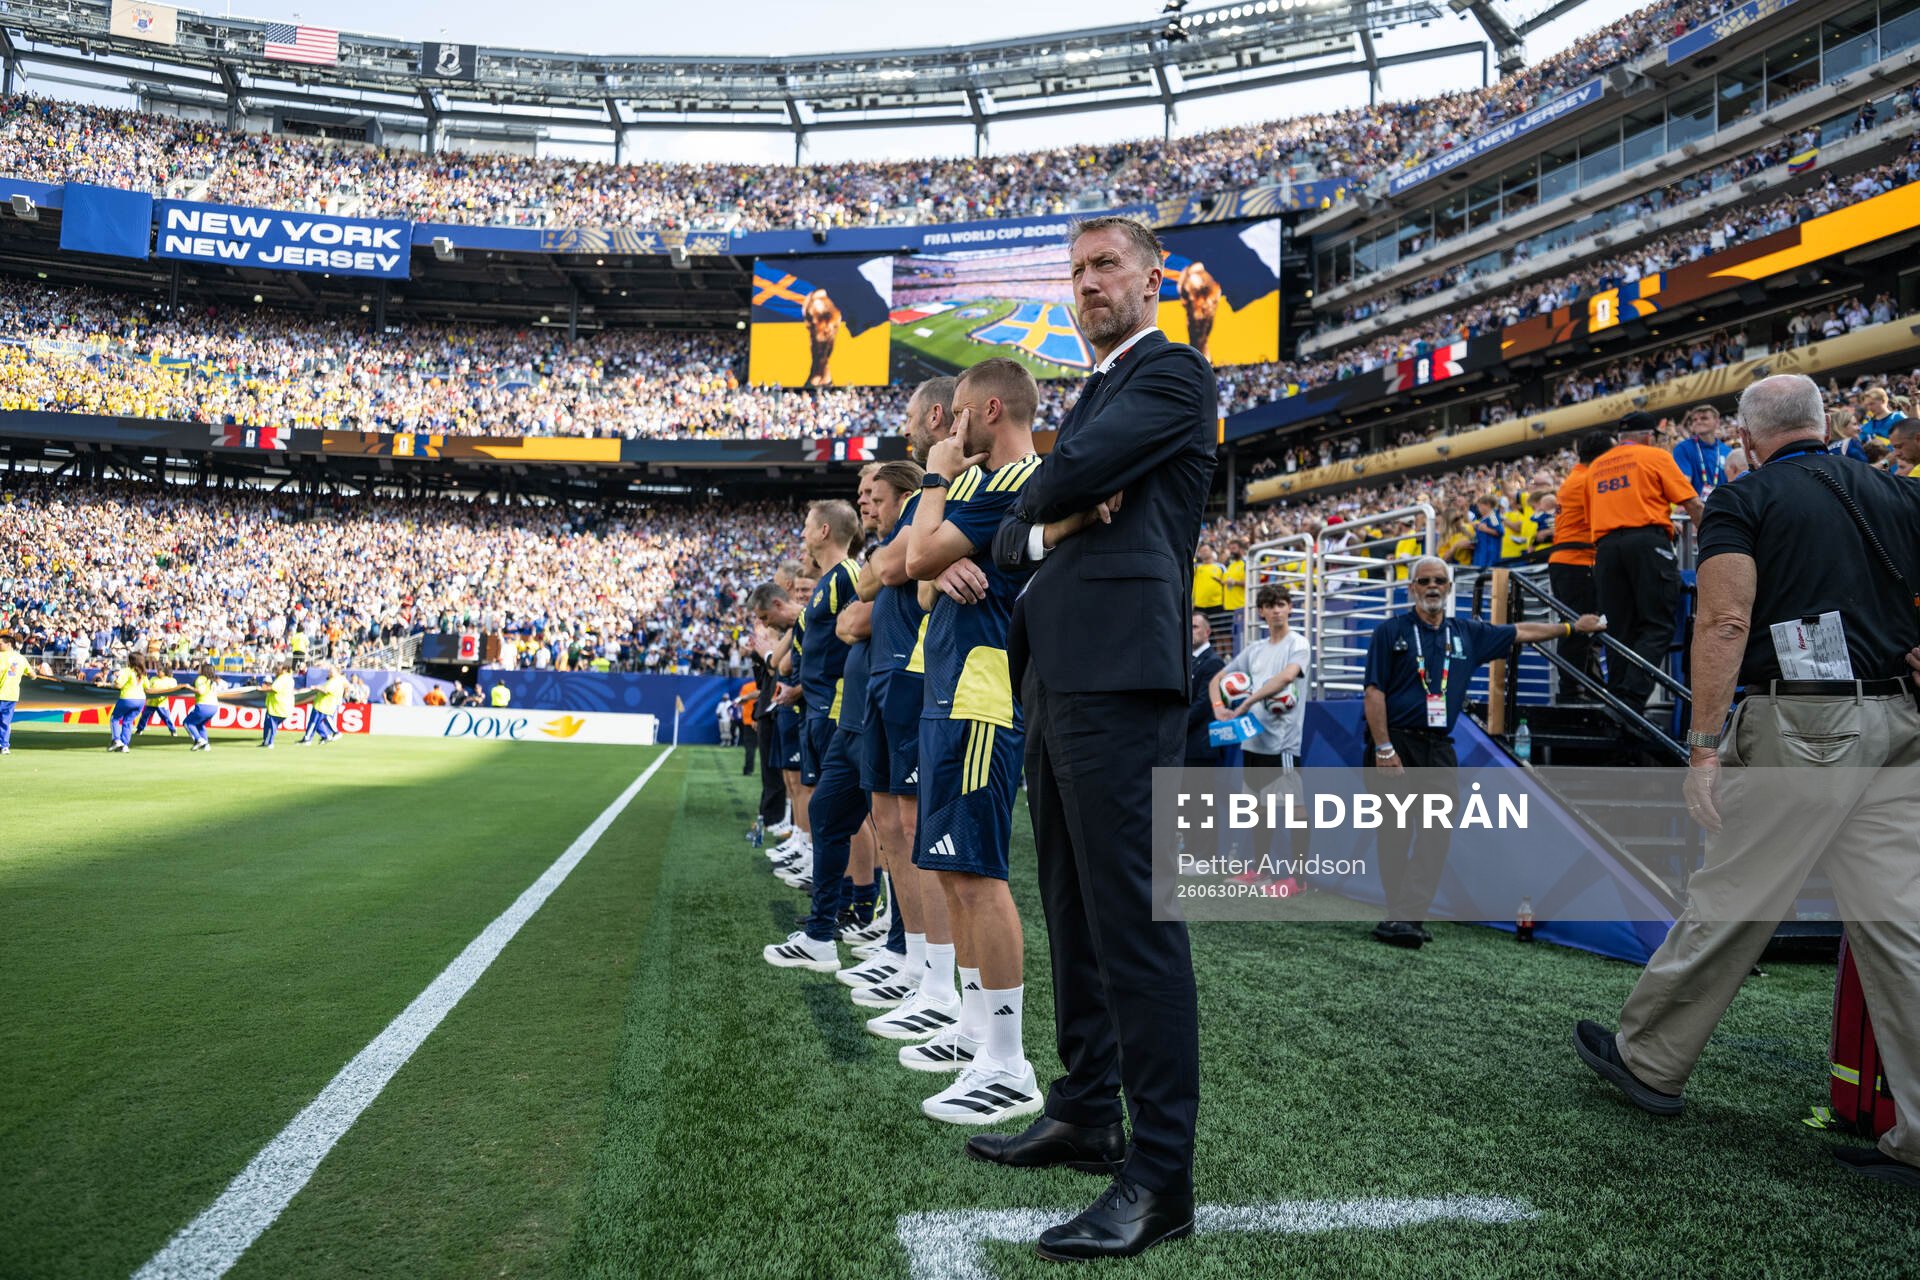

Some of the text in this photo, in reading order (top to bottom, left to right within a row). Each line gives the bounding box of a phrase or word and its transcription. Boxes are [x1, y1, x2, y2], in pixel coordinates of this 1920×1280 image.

[1396, 87, 1592, 189] NEW YORK NEW JERSEY
[167, 208, 402, 250] NEW YORK
[923, 223, 1068, 246] FIFA WORLD CUP 2026
[165, 235, 401, 272] NEW JERSEY
[1597, 475, 1630, 494] 581
[443, 707, 528, 740] Dove
